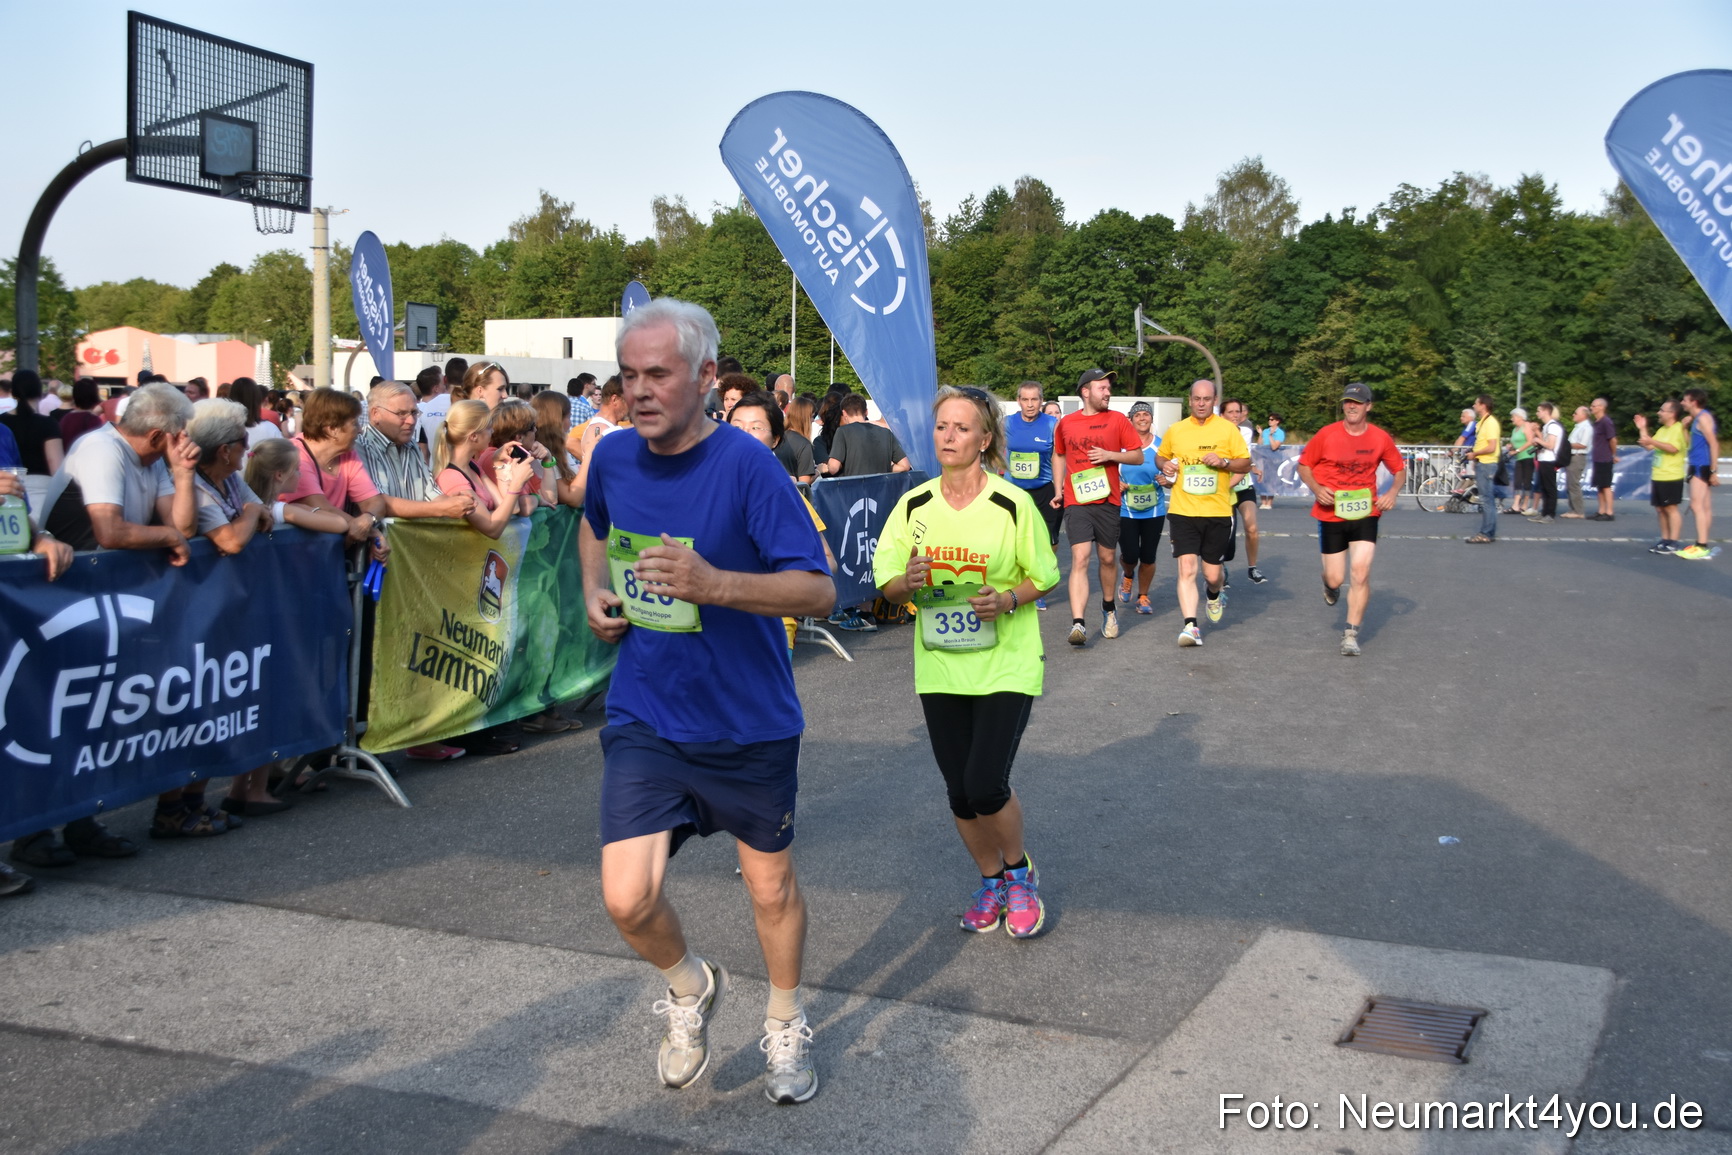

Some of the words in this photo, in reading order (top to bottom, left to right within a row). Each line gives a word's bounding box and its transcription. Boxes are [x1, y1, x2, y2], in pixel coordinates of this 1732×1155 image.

[1015, 463, 1033, 472] 561
[1077, 479, 1106, 495] 1534
[1187, 476, 1215, 487] 1525
[1133, 494, 1152, 504] 554
[1339, 500, 1369, 512] 1533
[925, 545, 990, 564] Müller
[652, 611, 672, 619] Hoppe
[935, 610, 982, 635] 339
[51, 642, 272, 739] Fischer
[74, 704, 260, 776] AUTOMOBILE
